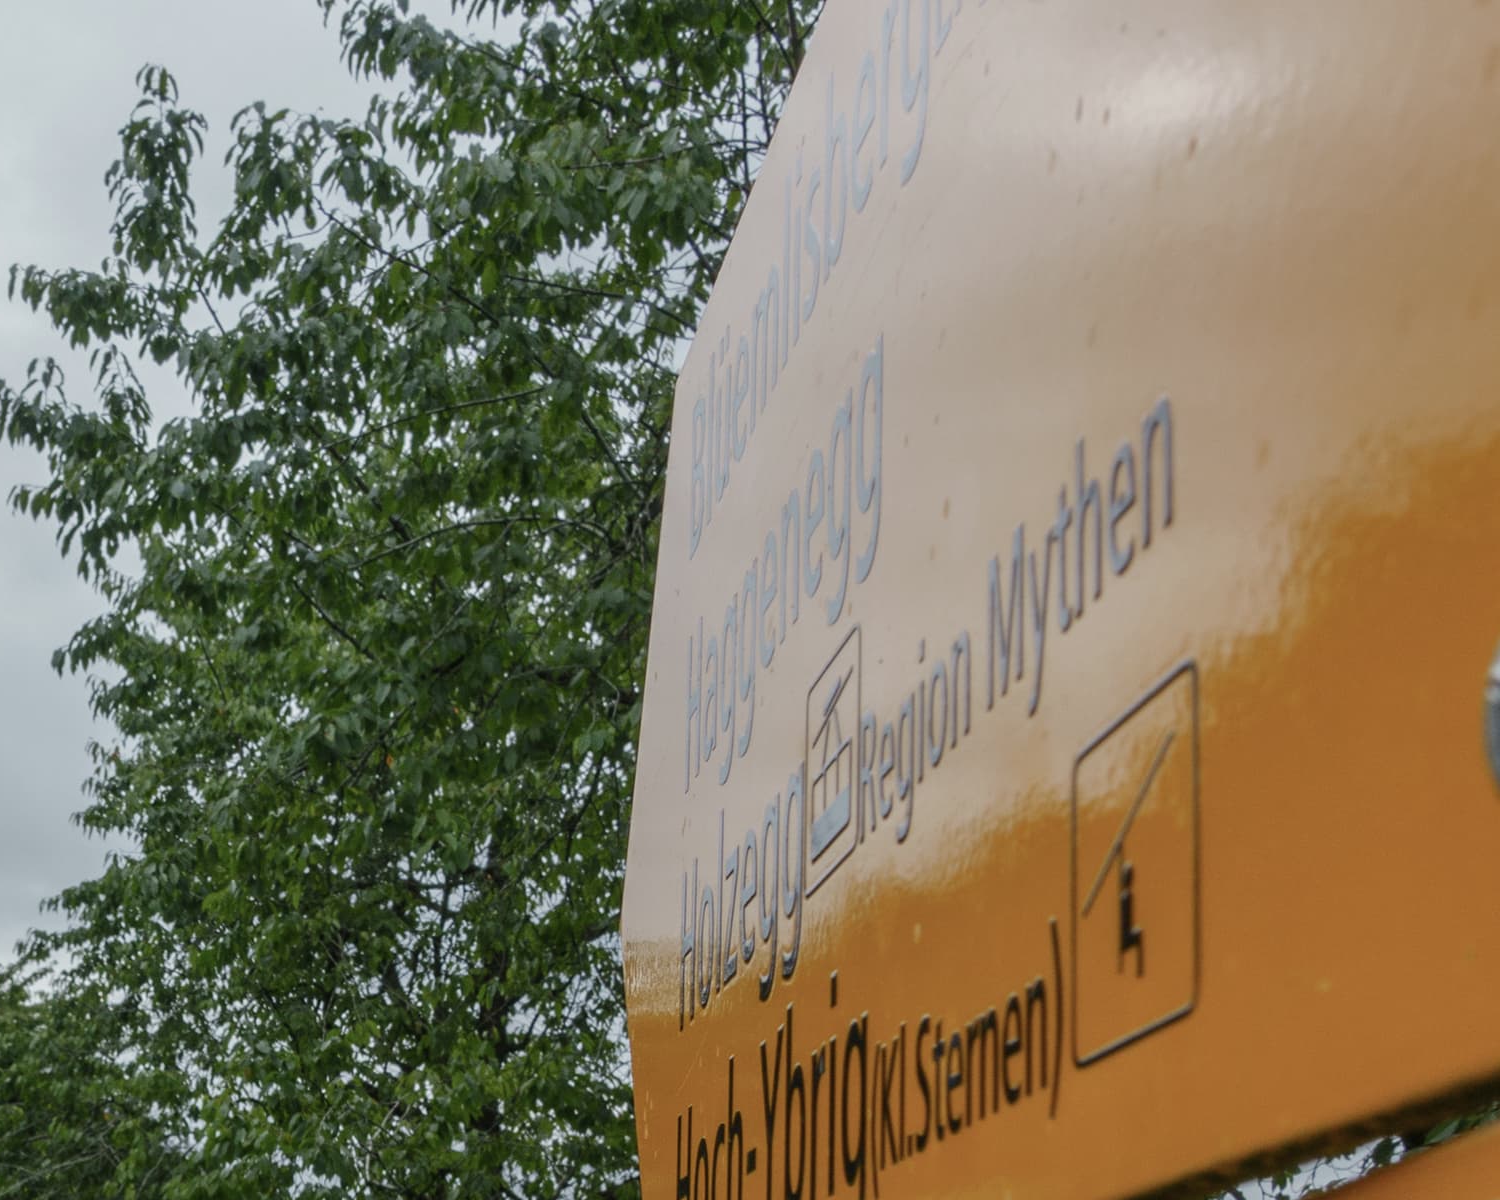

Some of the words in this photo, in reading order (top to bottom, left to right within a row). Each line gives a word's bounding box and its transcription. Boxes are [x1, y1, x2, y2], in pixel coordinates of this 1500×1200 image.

[679, 759, 805, 1032] Holzegg
[858, 628, 971, 846] Region
[986, 395, 1173, 719] Mythen
[684, 333, 883, 795] Haggenegg
